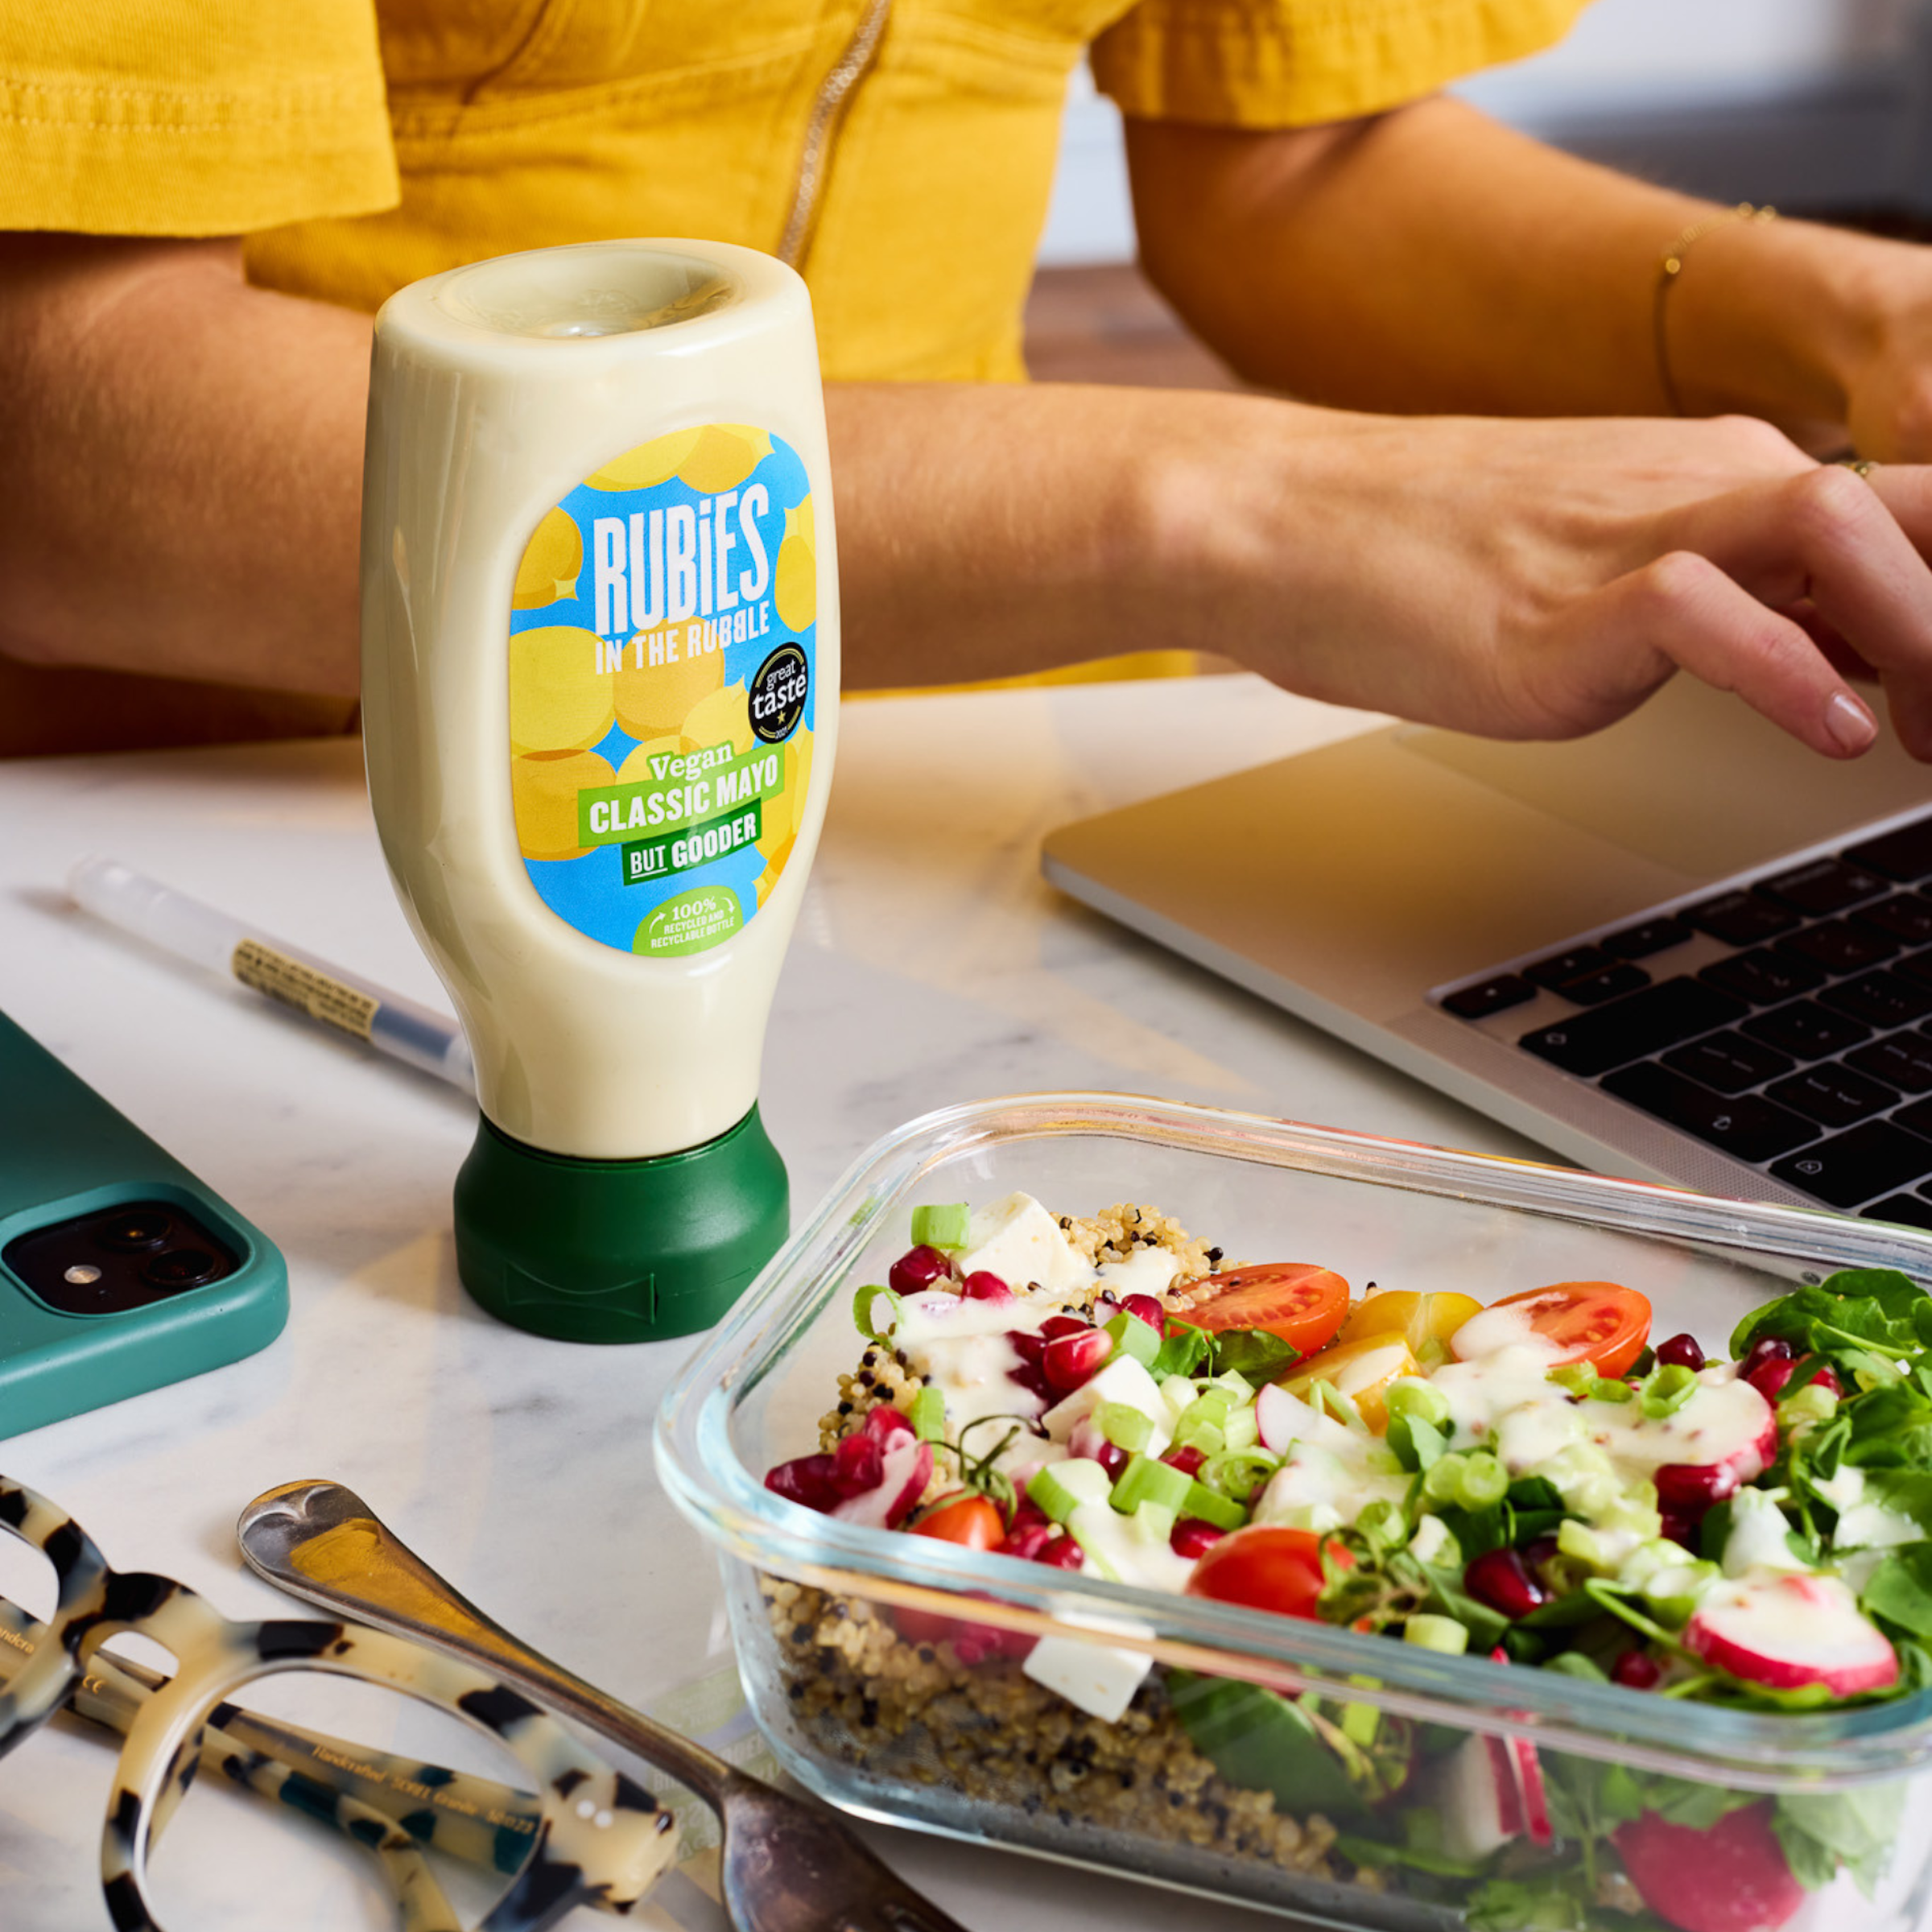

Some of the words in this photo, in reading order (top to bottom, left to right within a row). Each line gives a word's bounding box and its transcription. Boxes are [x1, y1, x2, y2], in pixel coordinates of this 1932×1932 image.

[595, 638, 623, 675] IN
[632, 628, 679, 670] THE
[687, 600, 770, 659] RUBBLE
[766, 658, 796, 691] great
[752, 671, 807, 720] taste
[650, 743, 733, 781] Vegan
[589, 781, 711, 834] CLASSIC
[716, 754, 778, 808] MAYO
[630, 845, 668, 875] BUT
[671, 812, 757, 869] GOODER
[664, 915, 707, 935] RECYCLED
[708, 910, 724, 923] AND
[672, 895, 716, 921] 100%
[650, 927, 705, 949] RECYCLABLE
[707, 916, 734, 935] BOTTLE
